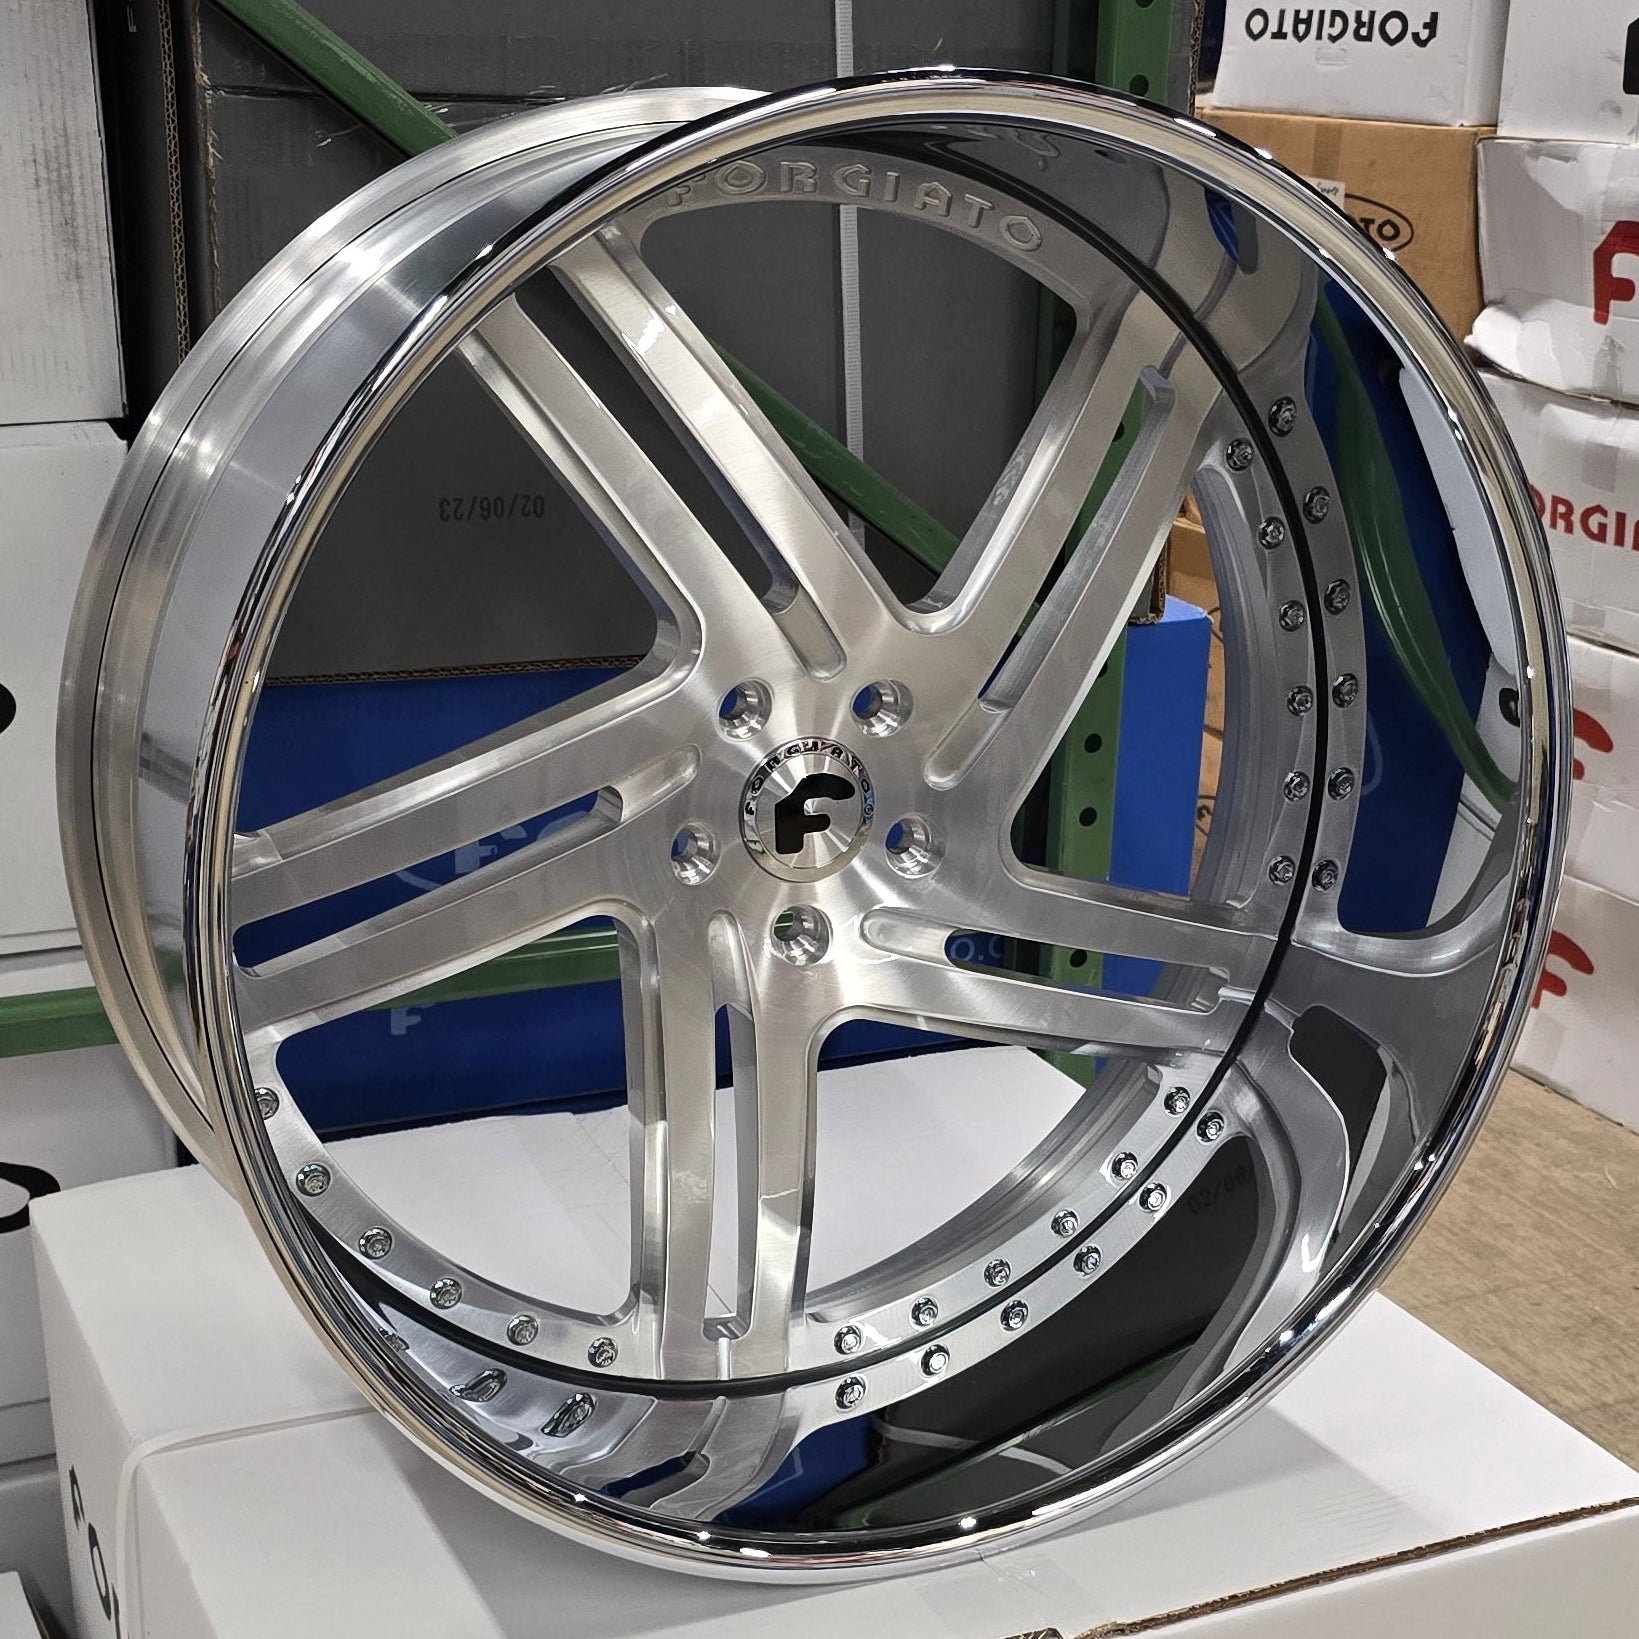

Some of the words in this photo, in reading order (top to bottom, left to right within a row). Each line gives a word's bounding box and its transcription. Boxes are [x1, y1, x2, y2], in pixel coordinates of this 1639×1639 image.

[1245, 8, 1439, 48] FORGIATO
[665, 159, 1042, 252] FORGIATO
[1356, 215, 1400, 242] TO
[439, 493, 545, 523] 02/06/23
[1529, 484, 1639, 552] RGI
[774, 772, 856, 855] F
